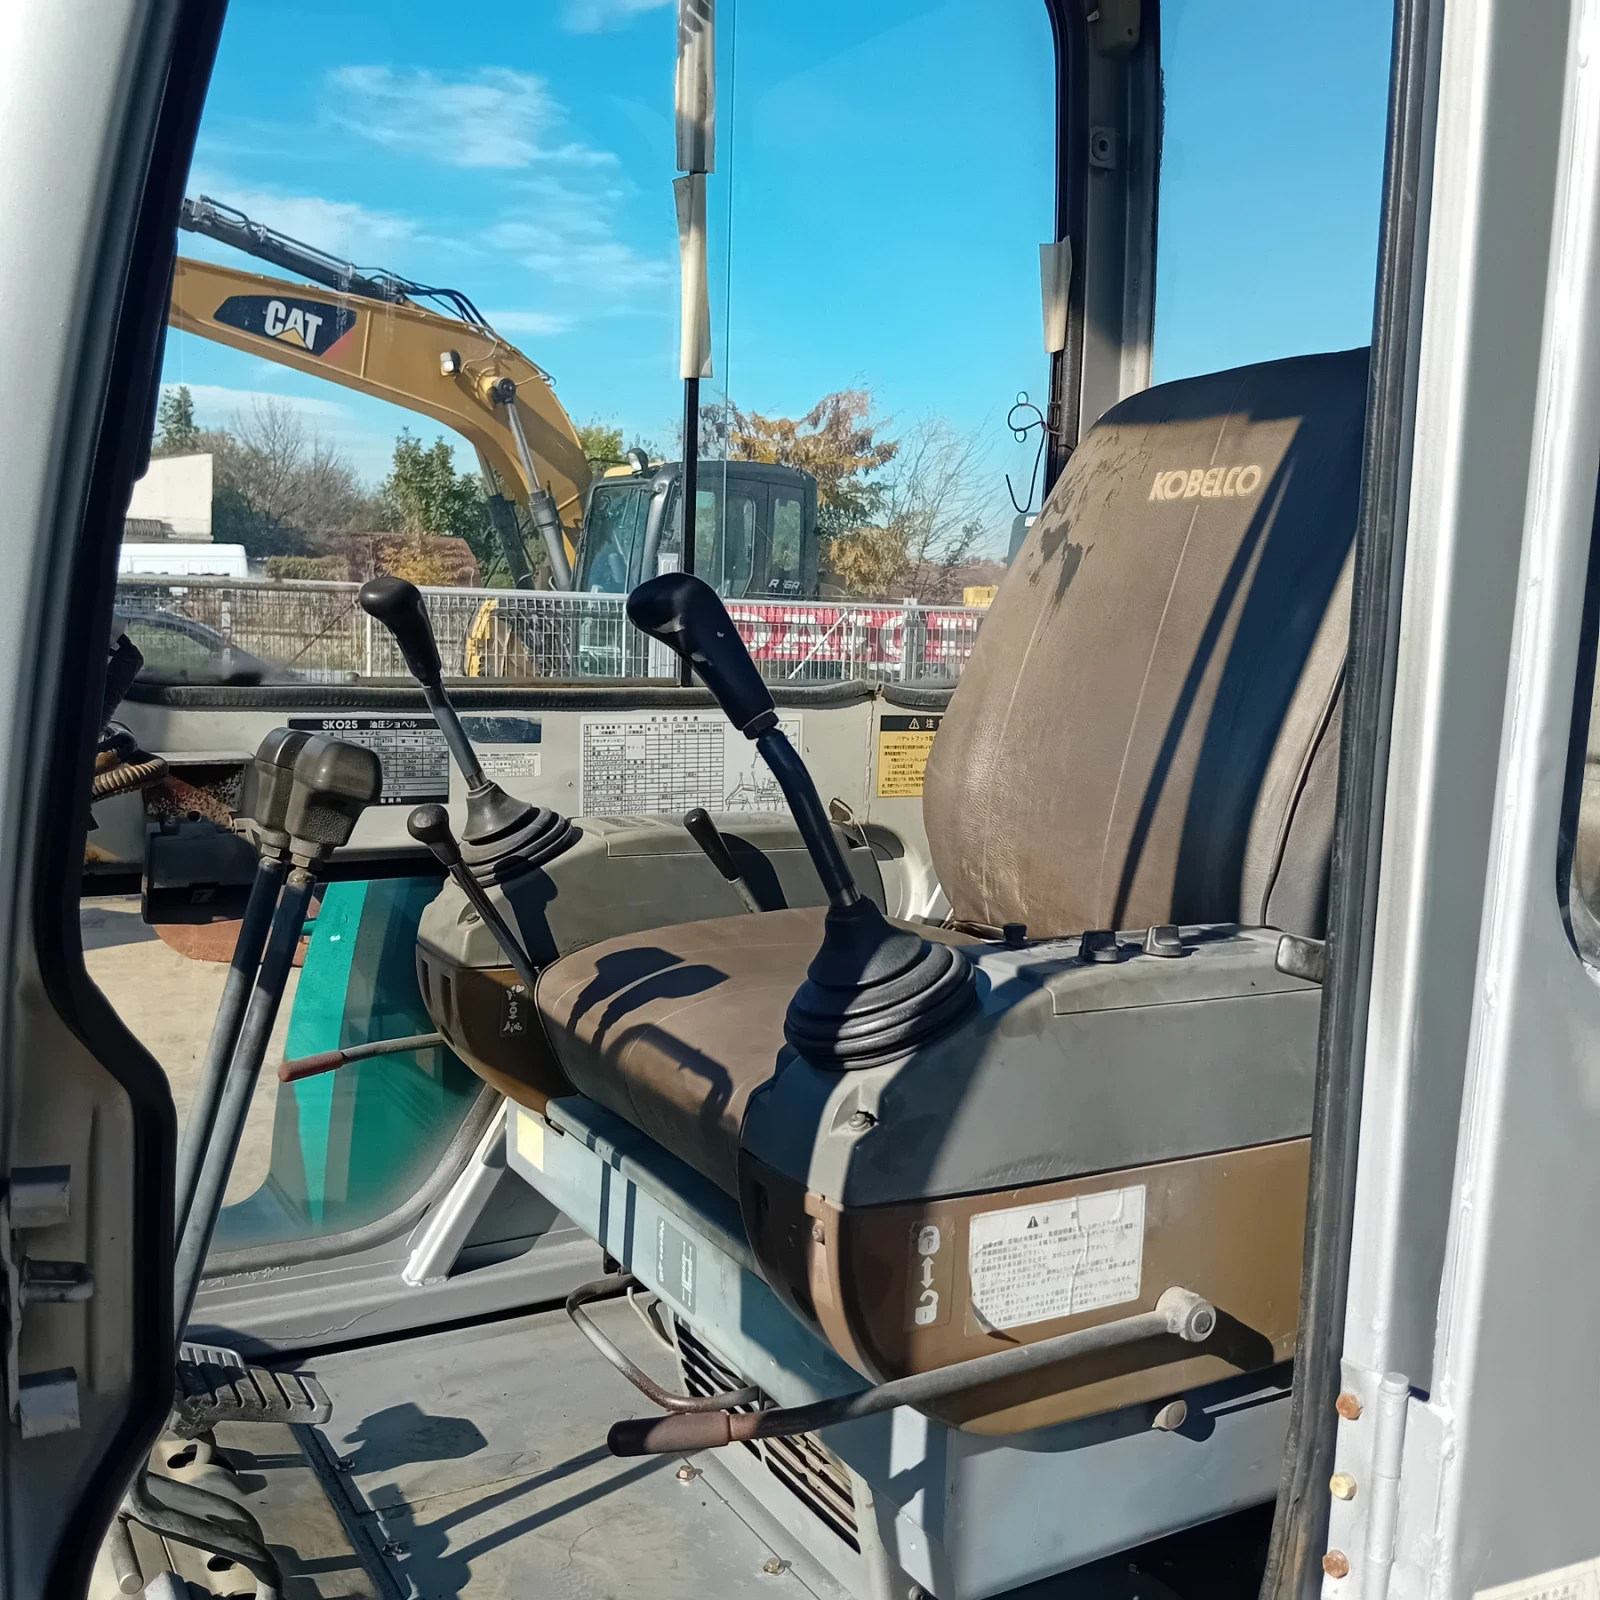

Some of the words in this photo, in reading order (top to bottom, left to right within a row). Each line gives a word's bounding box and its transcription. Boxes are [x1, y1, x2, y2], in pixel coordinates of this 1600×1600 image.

[264, 300, 323, 350] CAT
[1148, 464, 1262, 501] KOBELCO
[369, 720, 418, 729] 油圧ショベル
